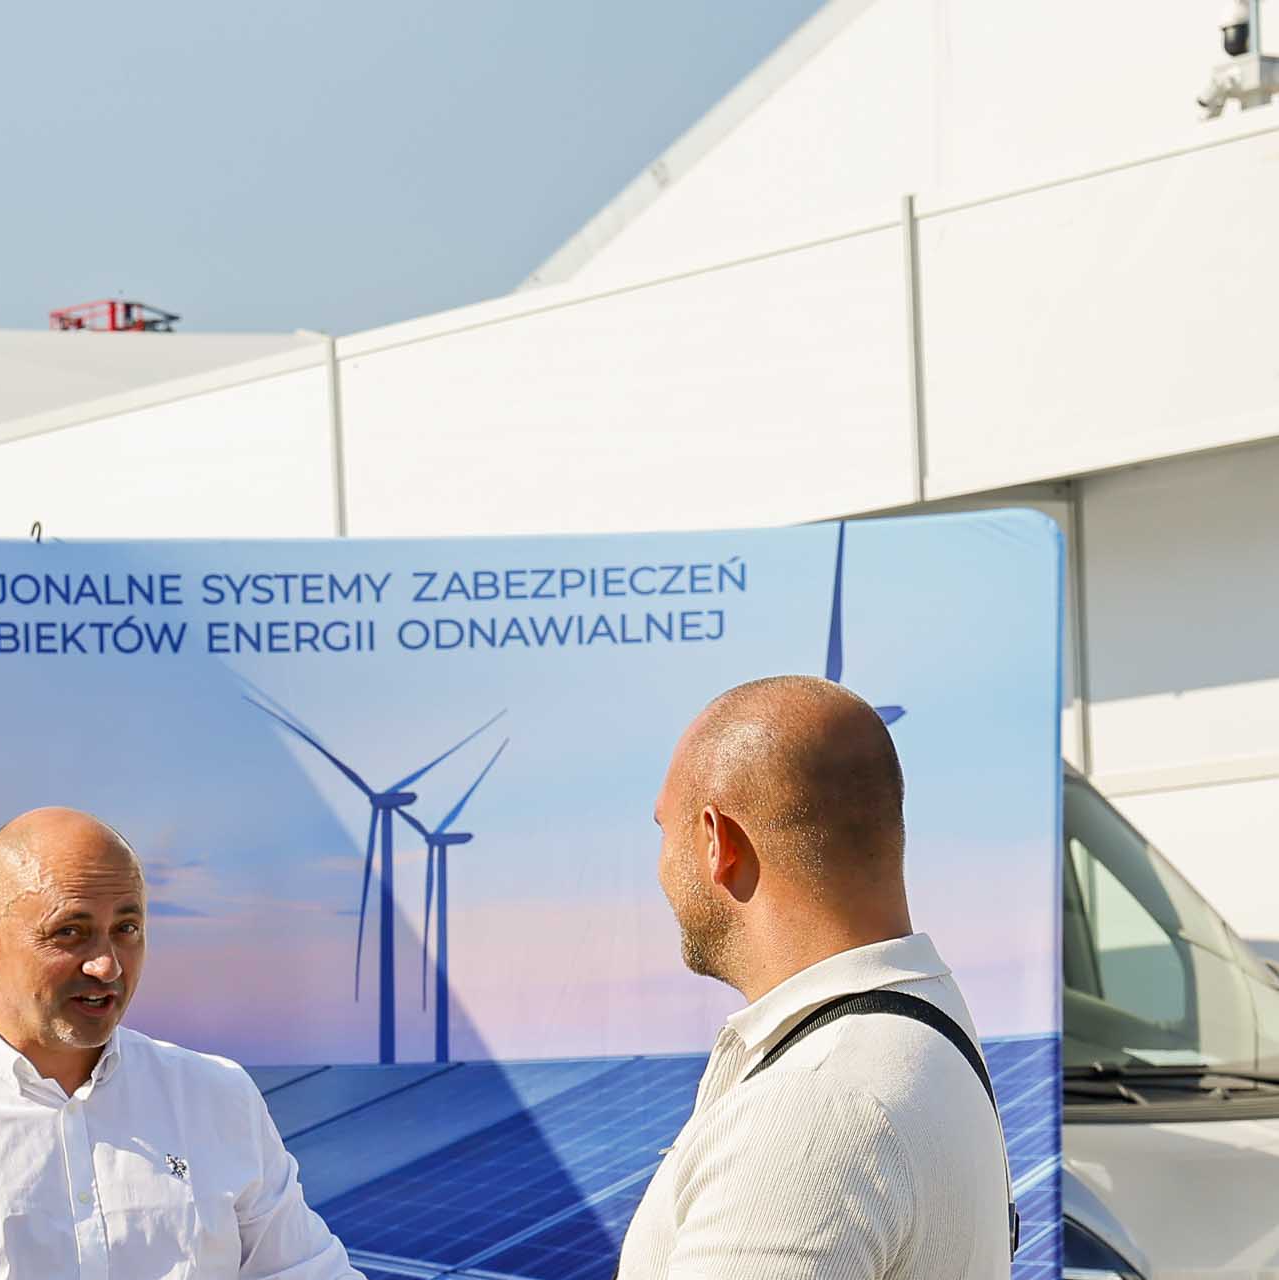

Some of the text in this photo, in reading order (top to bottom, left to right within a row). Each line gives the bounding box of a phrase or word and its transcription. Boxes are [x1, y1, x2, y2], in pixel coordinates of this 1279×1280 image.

[202, 573, 392, 605] SYSTEMY
[412, 556, 746, 602] ZABEZPIECZEŃ
[208, 621, 375, 653] ENERGII
[398, 610, 724, 650] ODNAWIALNEJ
